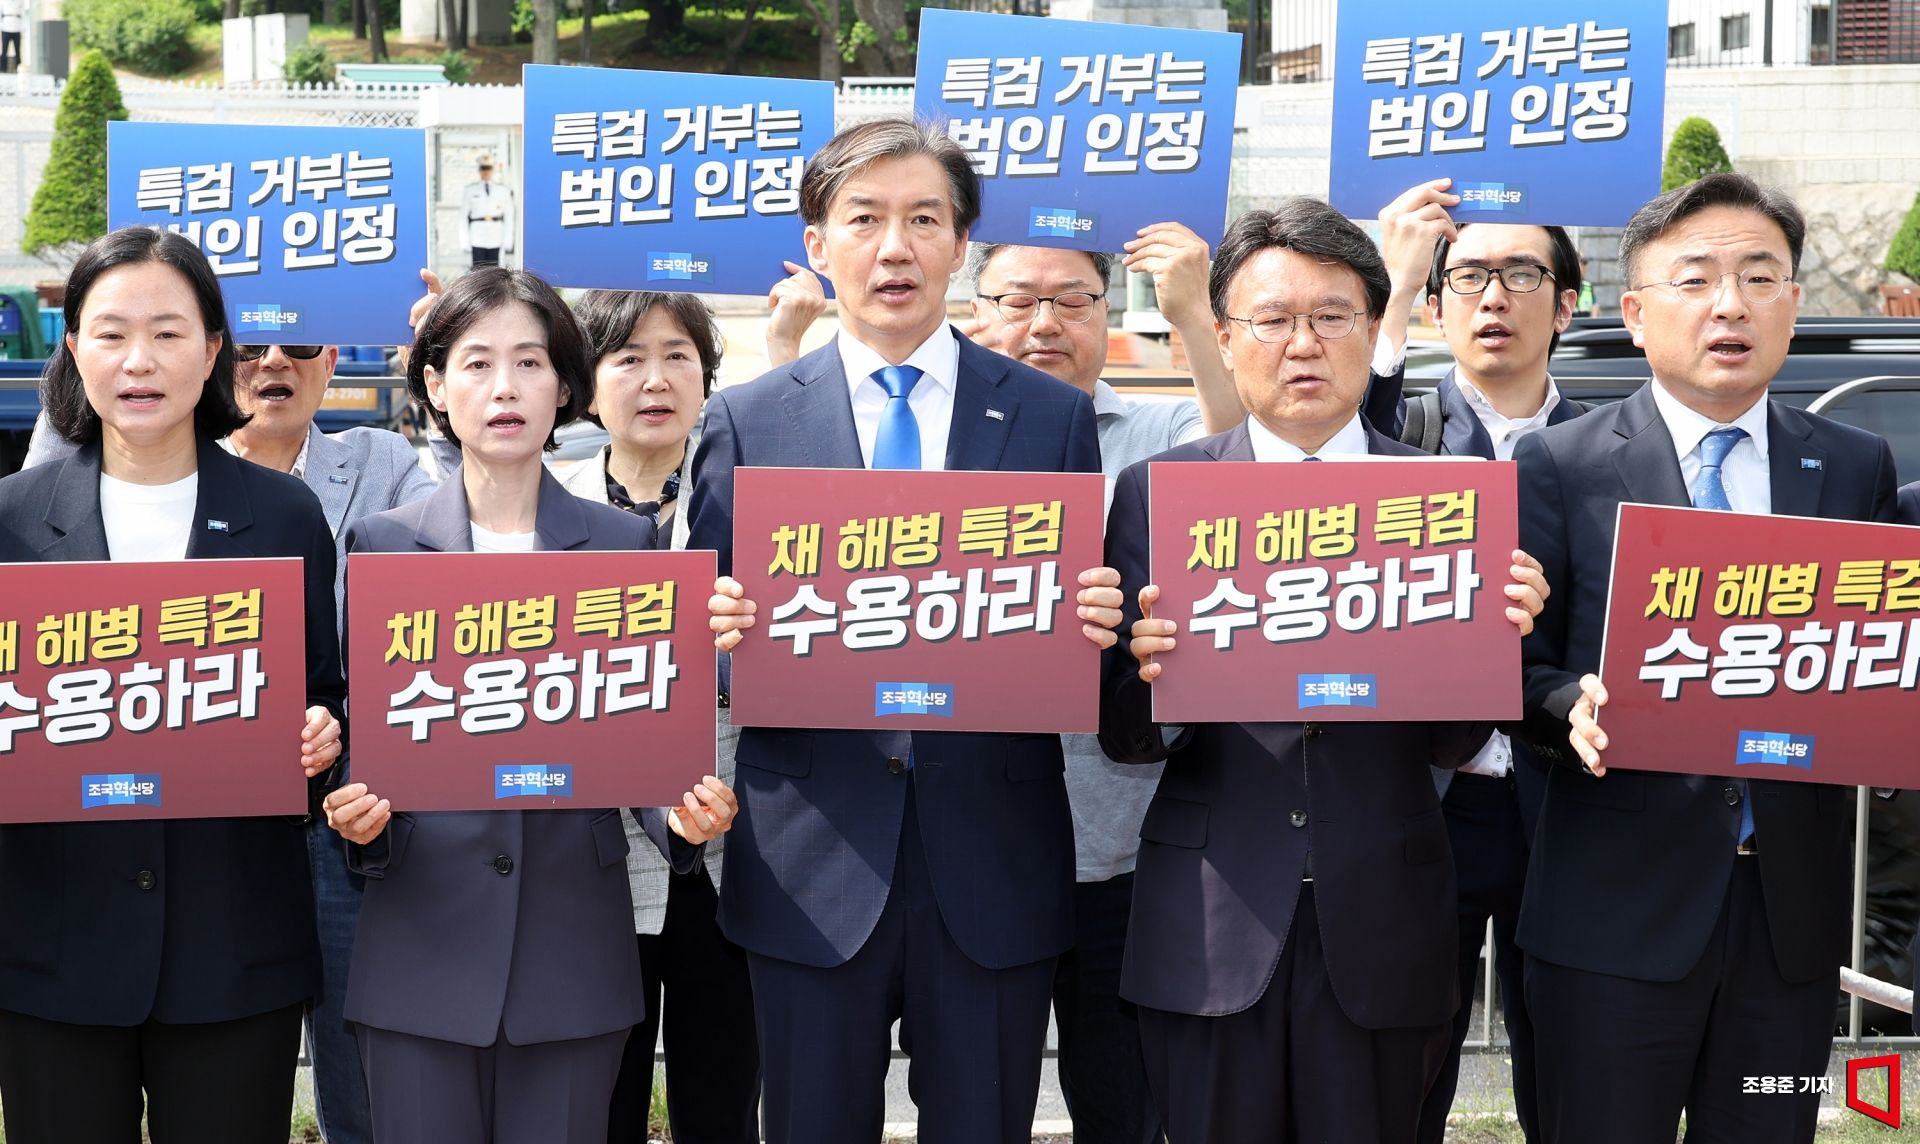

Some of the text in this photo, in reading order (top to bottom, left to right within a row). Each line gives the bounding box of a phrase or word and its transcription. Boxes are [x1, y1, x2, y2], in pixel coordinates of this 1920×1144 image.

[941, 51, 1204, 107] 특검 거부는
[1362, 20, 1631, 86] 특검 거부는
[551, 102, 801, 159] 특검 거부는
[947, 110, 1205, 176] 범인 인정
[1368, 77, 1631, 157] 범인 인정
[136, 150, 395, 214] 특검 거부는
[560, 155, 804, 226] 범인 인정
[1462, 189, 1522, 204] 조국혁신당
[282, 203, 395, 269] 인정
[1035, 215, 1093, 231] 조국혁신당
[653, 259, 708, 273] 조국혁신당
[241, 310, 298, 324] 조국혁신당
[768, 500, 1062, 574] 채 해병 특검
[1187, 488, 1476, 567] 채 해병 특검
[384, 580, 674, 662] 채 해병 특검
[768, 560, 1062, 655] 수용하라
[1189, 548, 1480, 649] 수용하라
[1644, 565, 1701, 620] 채
[1713, 562, 1819, 616] 해병
[36, 604, 139, 665] 해병
[157, 588, 261, 647] 특검
[1638, 618, 1920, 698] 수용하라
[0, 647, 265, 752] 수용하라
[386, 640, 677, 741] 수용하라
[882, 690, 947, 706] 조국혁신당
[1305, 681, 1370, 698] 조국혁신당
[502, 772, 566, 787] 조국혁신당
[1743, 740, 1808, 757] 조국혁신당
[89, 781, 154, 797] 조국혁신당
